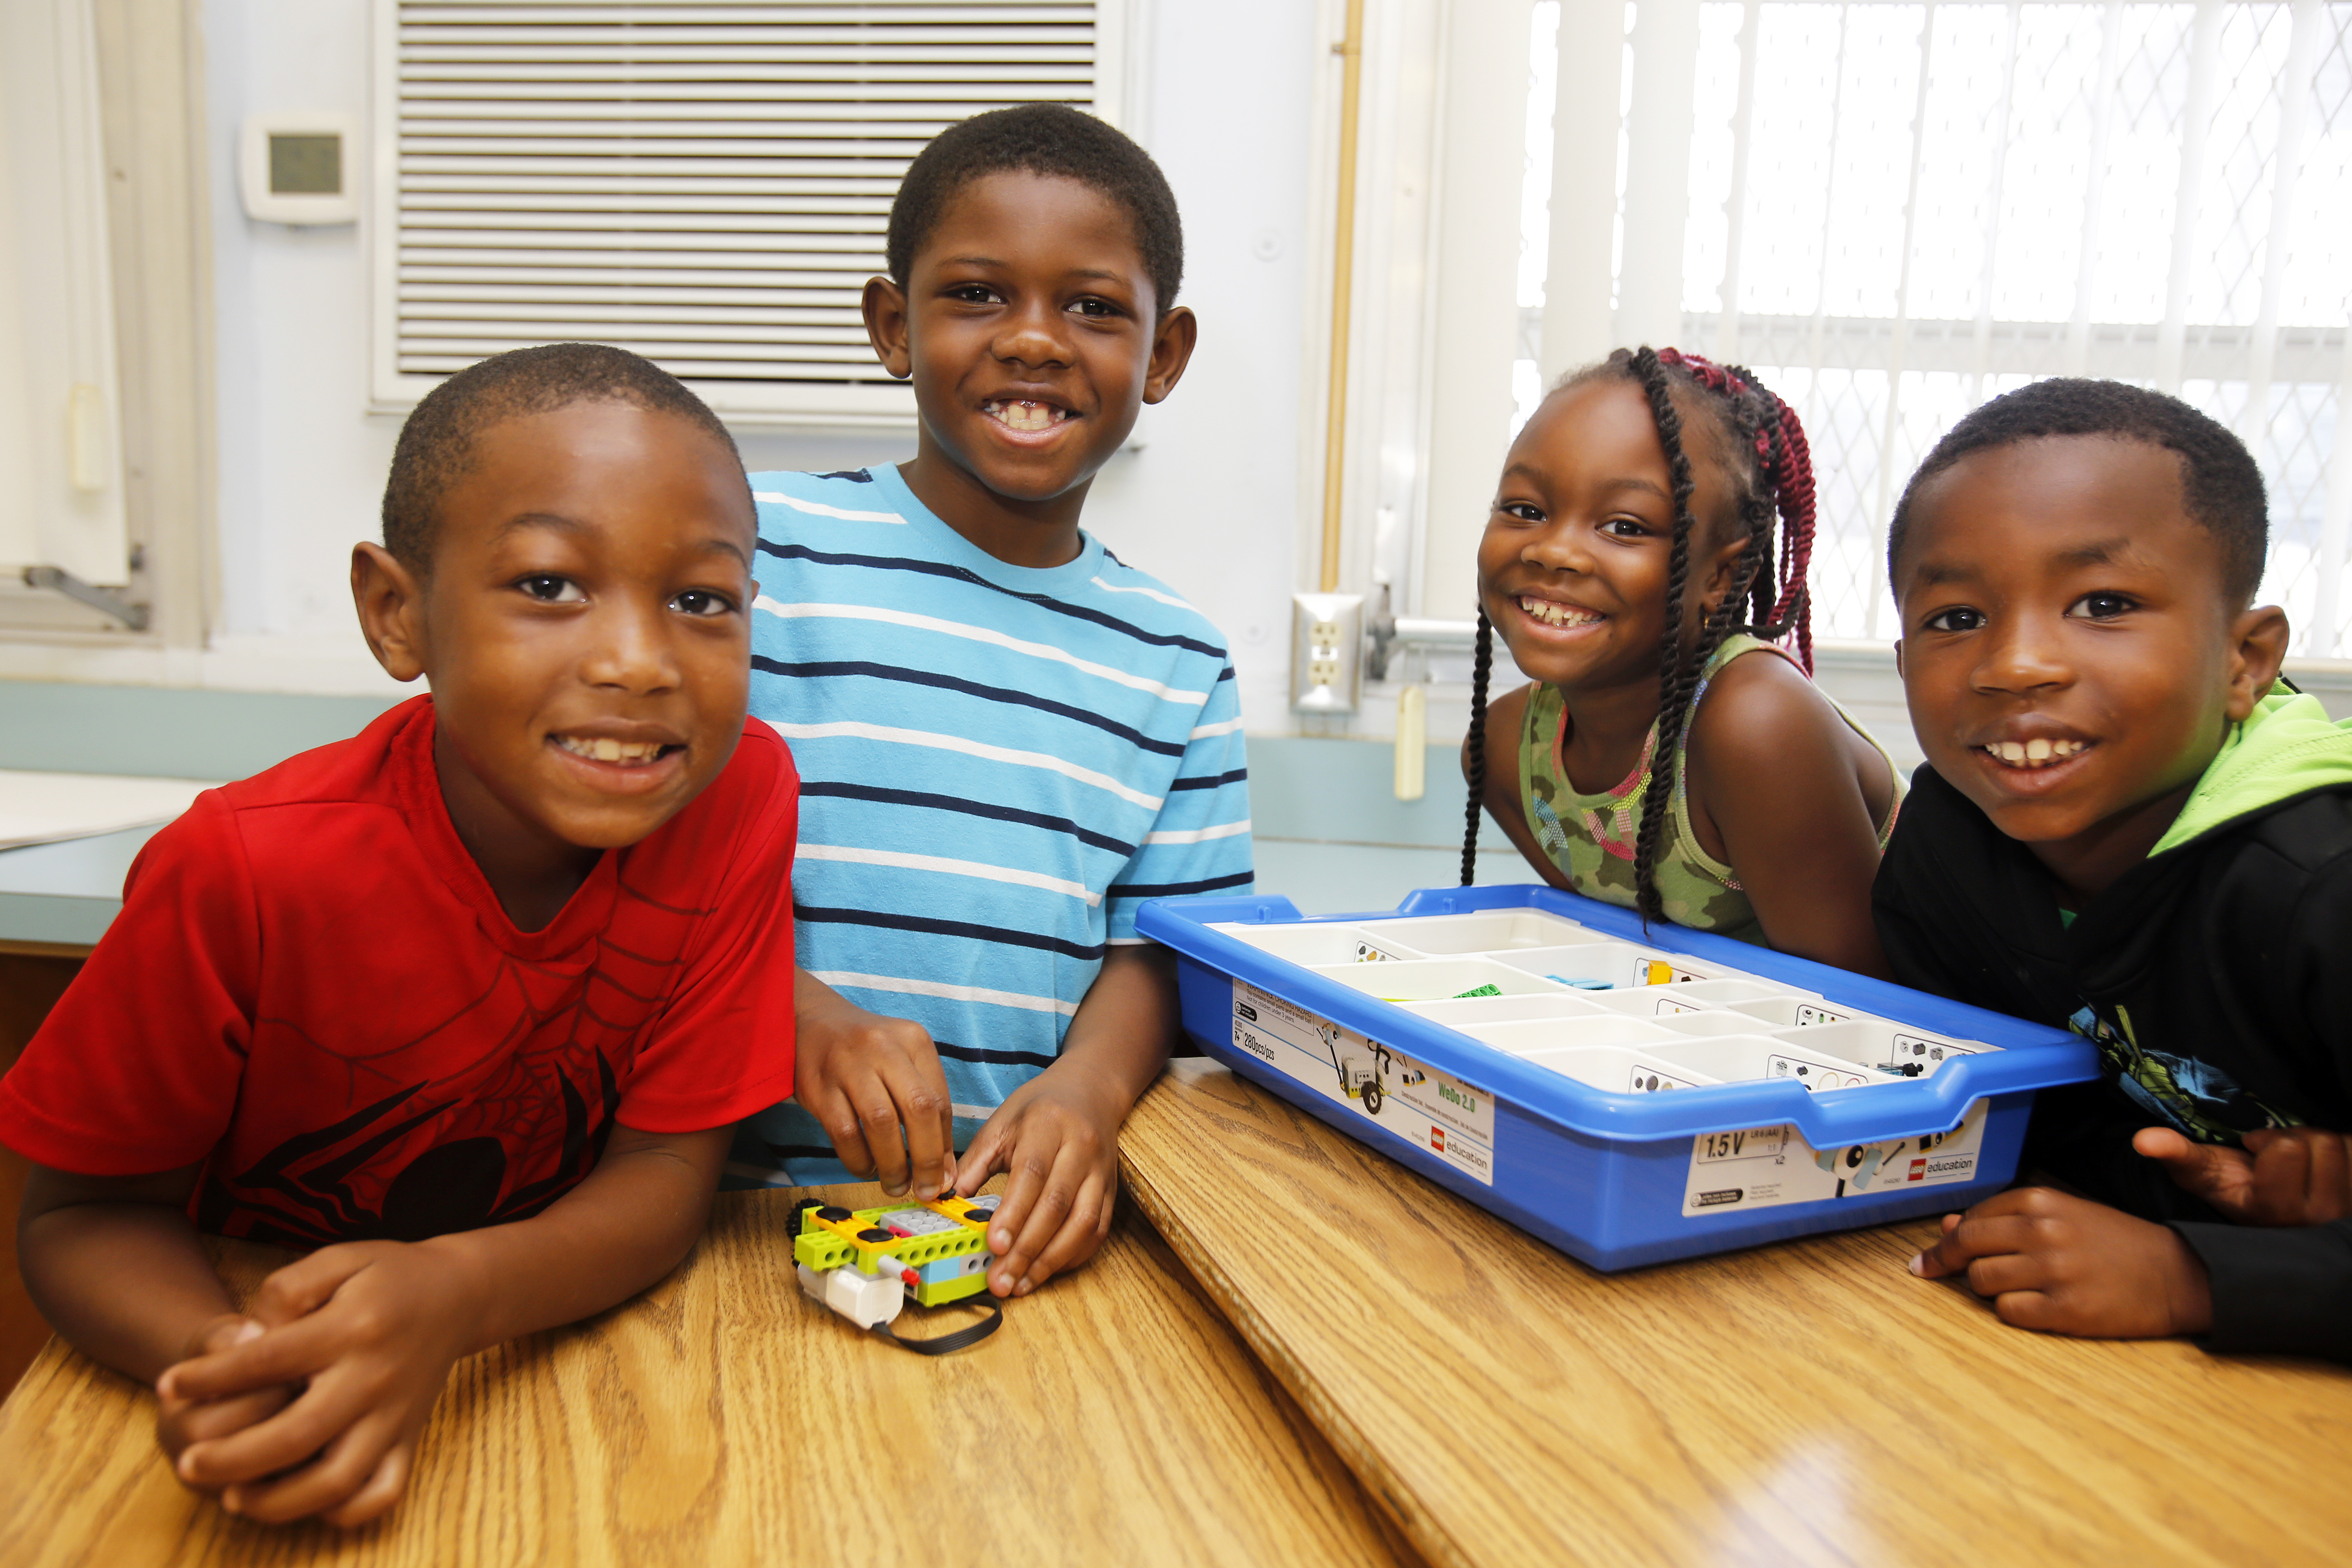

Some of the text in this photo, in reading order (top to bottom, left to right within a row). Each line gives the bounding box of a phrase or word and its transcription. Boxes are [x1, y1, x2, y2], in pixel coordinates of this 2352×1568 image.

[1253, 992, 1266, 1003] contains
[1276, 1003, 1284, 1012] parts
[1259, 1001, 1270, 1011] children
[1271, 1007, 1281, 1016] under
[1235, 1031, 1240, 1041] 7+
[1439, 1081, 1460, 1105] WeDo
[1463, 1094, 1476, 1112] 2.0
[1447, 1140, 1487, 1169] education
[1774, 1155, 1785, 1165] x2
[1910, 1158, 1972, 1174] LEGO education
